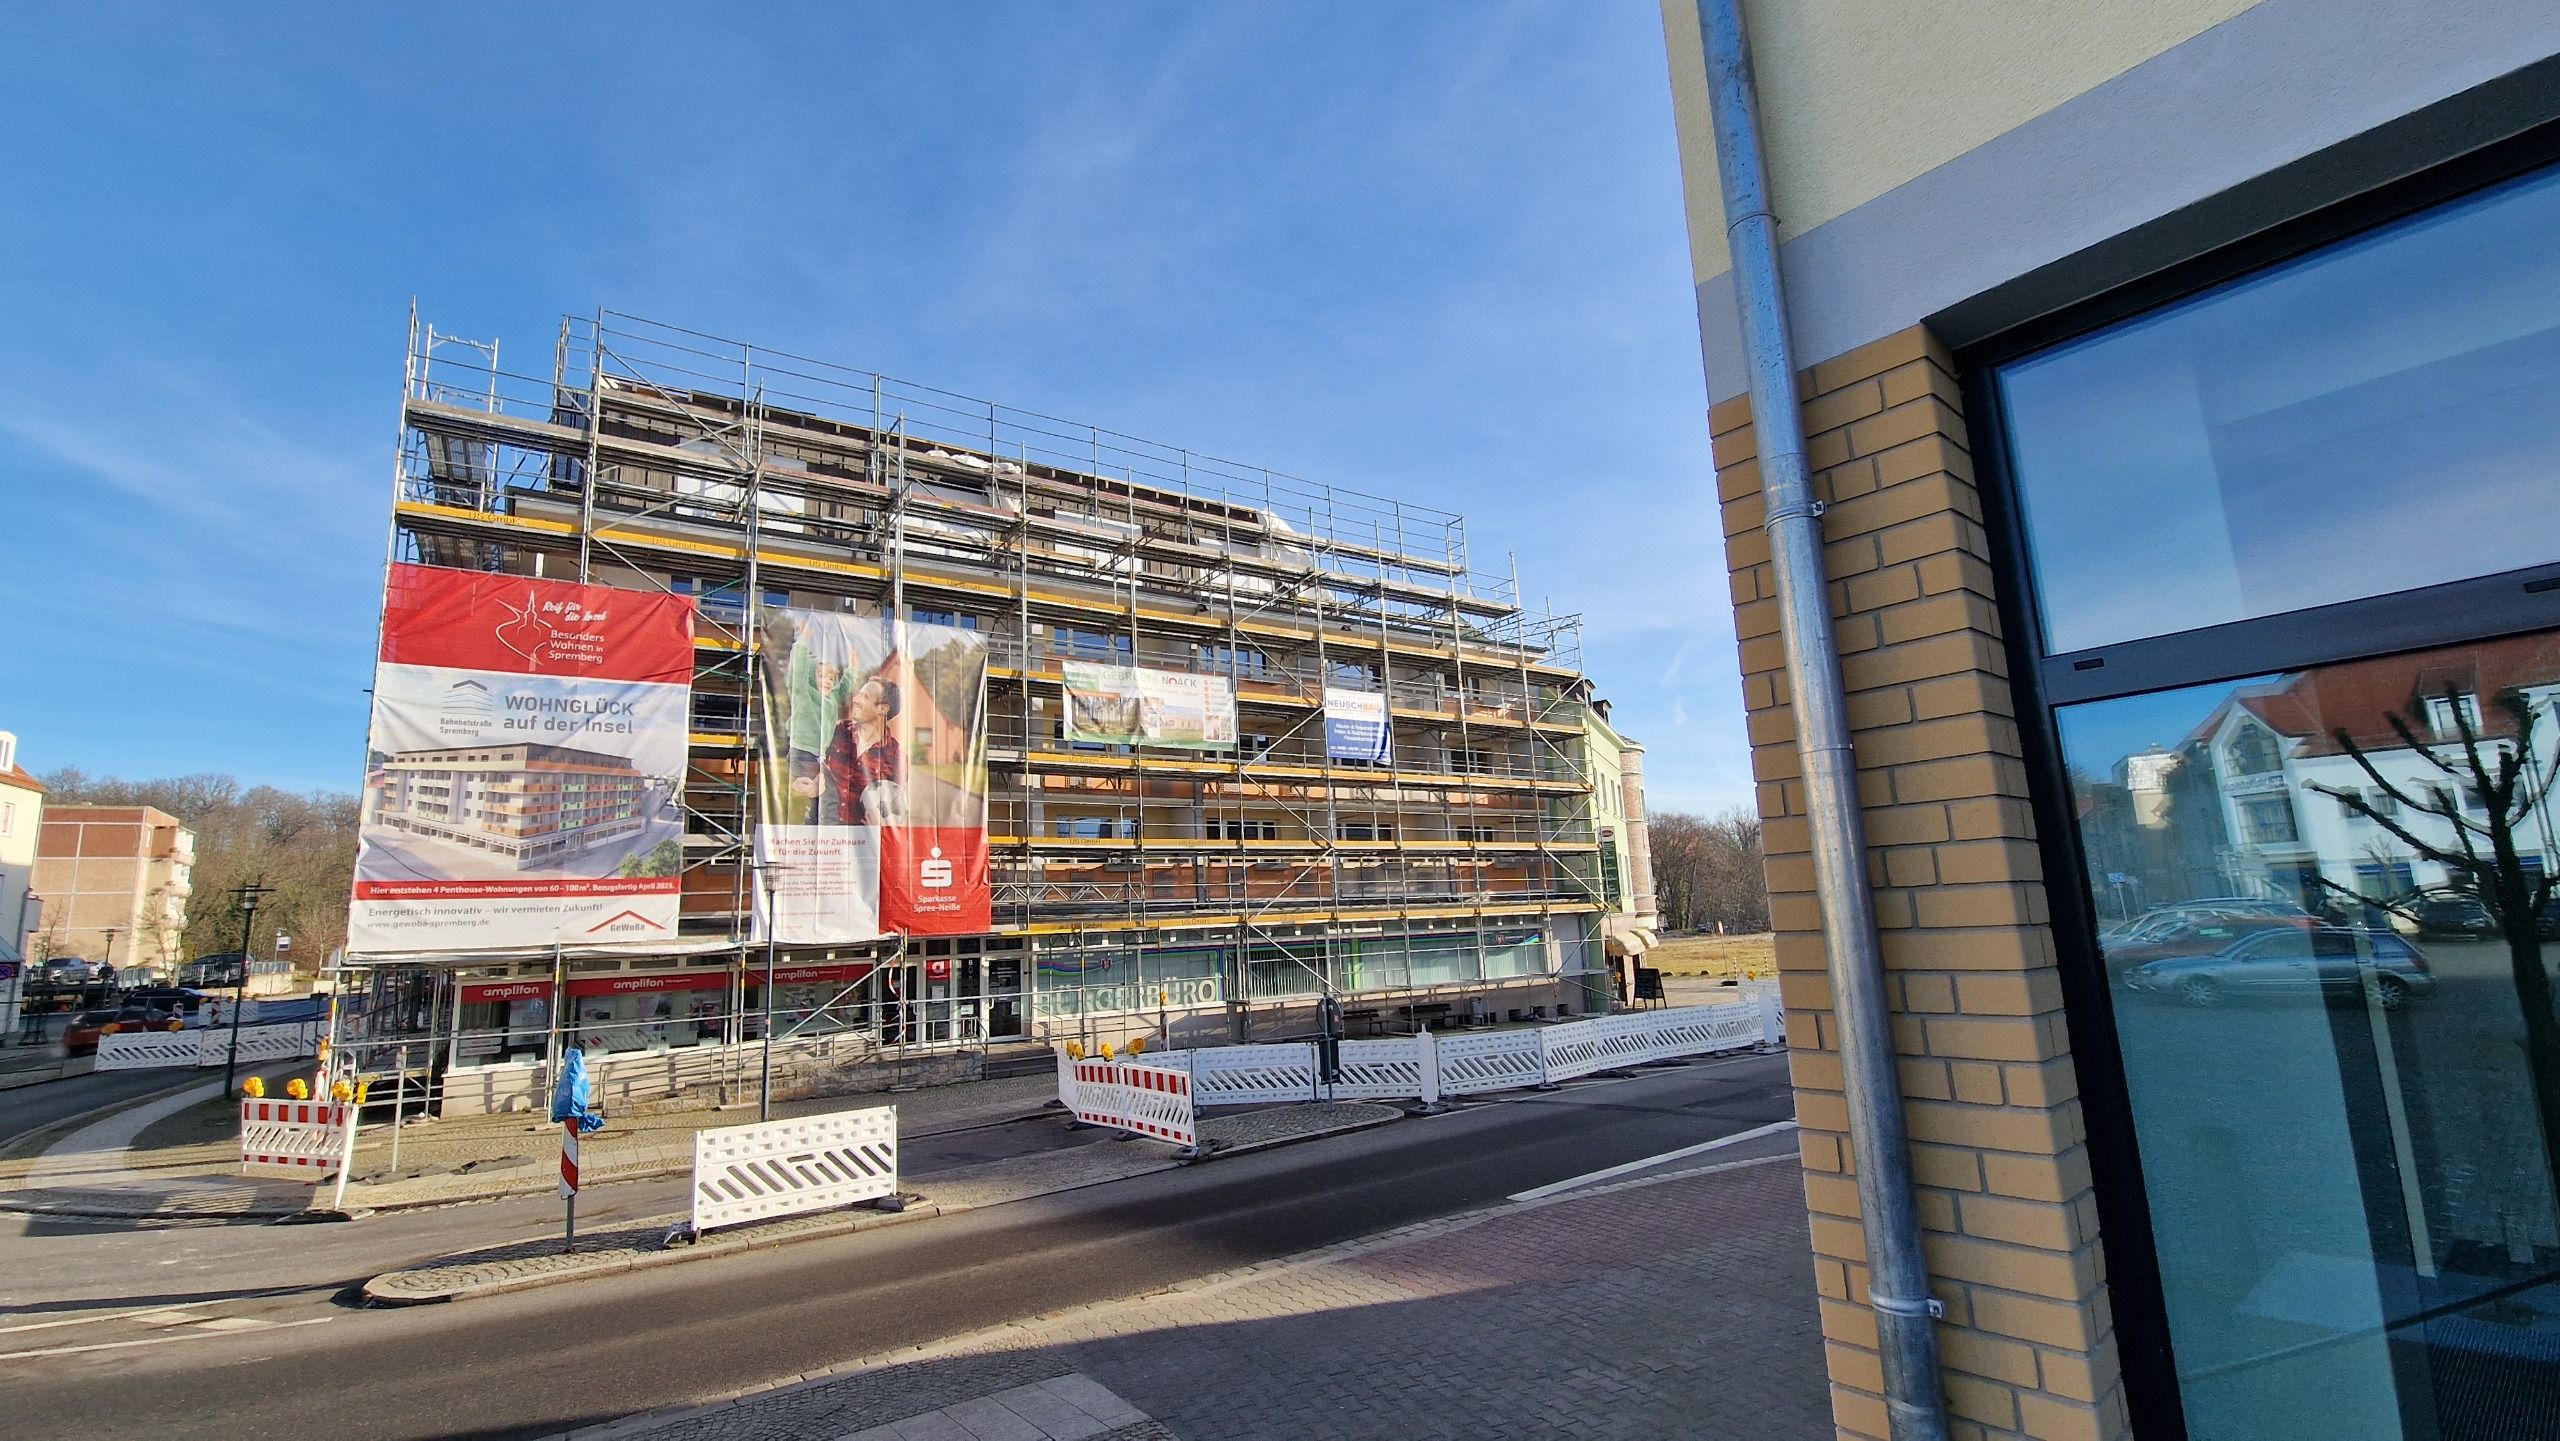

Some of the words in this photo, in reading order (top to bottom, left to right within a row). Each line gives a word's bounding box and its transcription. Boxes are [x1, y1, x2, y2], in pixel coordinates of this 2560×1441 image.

[551, 630, 605, 643] Besonders
[550, 640, 593, 651] Wohnen
[548, 650, 603, 664] Spremberg
[505, 695, 634, 716] WOHNGLÜCK
[503, 715, 537, 730] auf
[544, 717, 578, 731] der
[585, 718, 633, 734] Insel
[440, 727, 480, 737] Spremberg
[370, 886, 389, 894] Hier
[389, 886, 432, 894] entstehen
[433, 885, 439, 893] 4
[440, 884, 533, 894] Penthouse-Wohnungen
[593, 883, 637, 892] Bezugsfertig
[638, 882, 656, 891] April
[918, 894, 957, 904] Sparkasse
[368, 907, 431, 918] Energetisch
[434, 906, 482, 916] innovativ
[493, 906, 509, 914] wir
[511, 905, 560, 914] vermieten
[563, 903, 603, 912] Zukunft!
[913, 903, 962, 913] Spree-Neiße
[774, 970, 818, 980] amplifon
[613, 978, 664, 990] amplifon
[483, 985, 540, 998] amplifon
